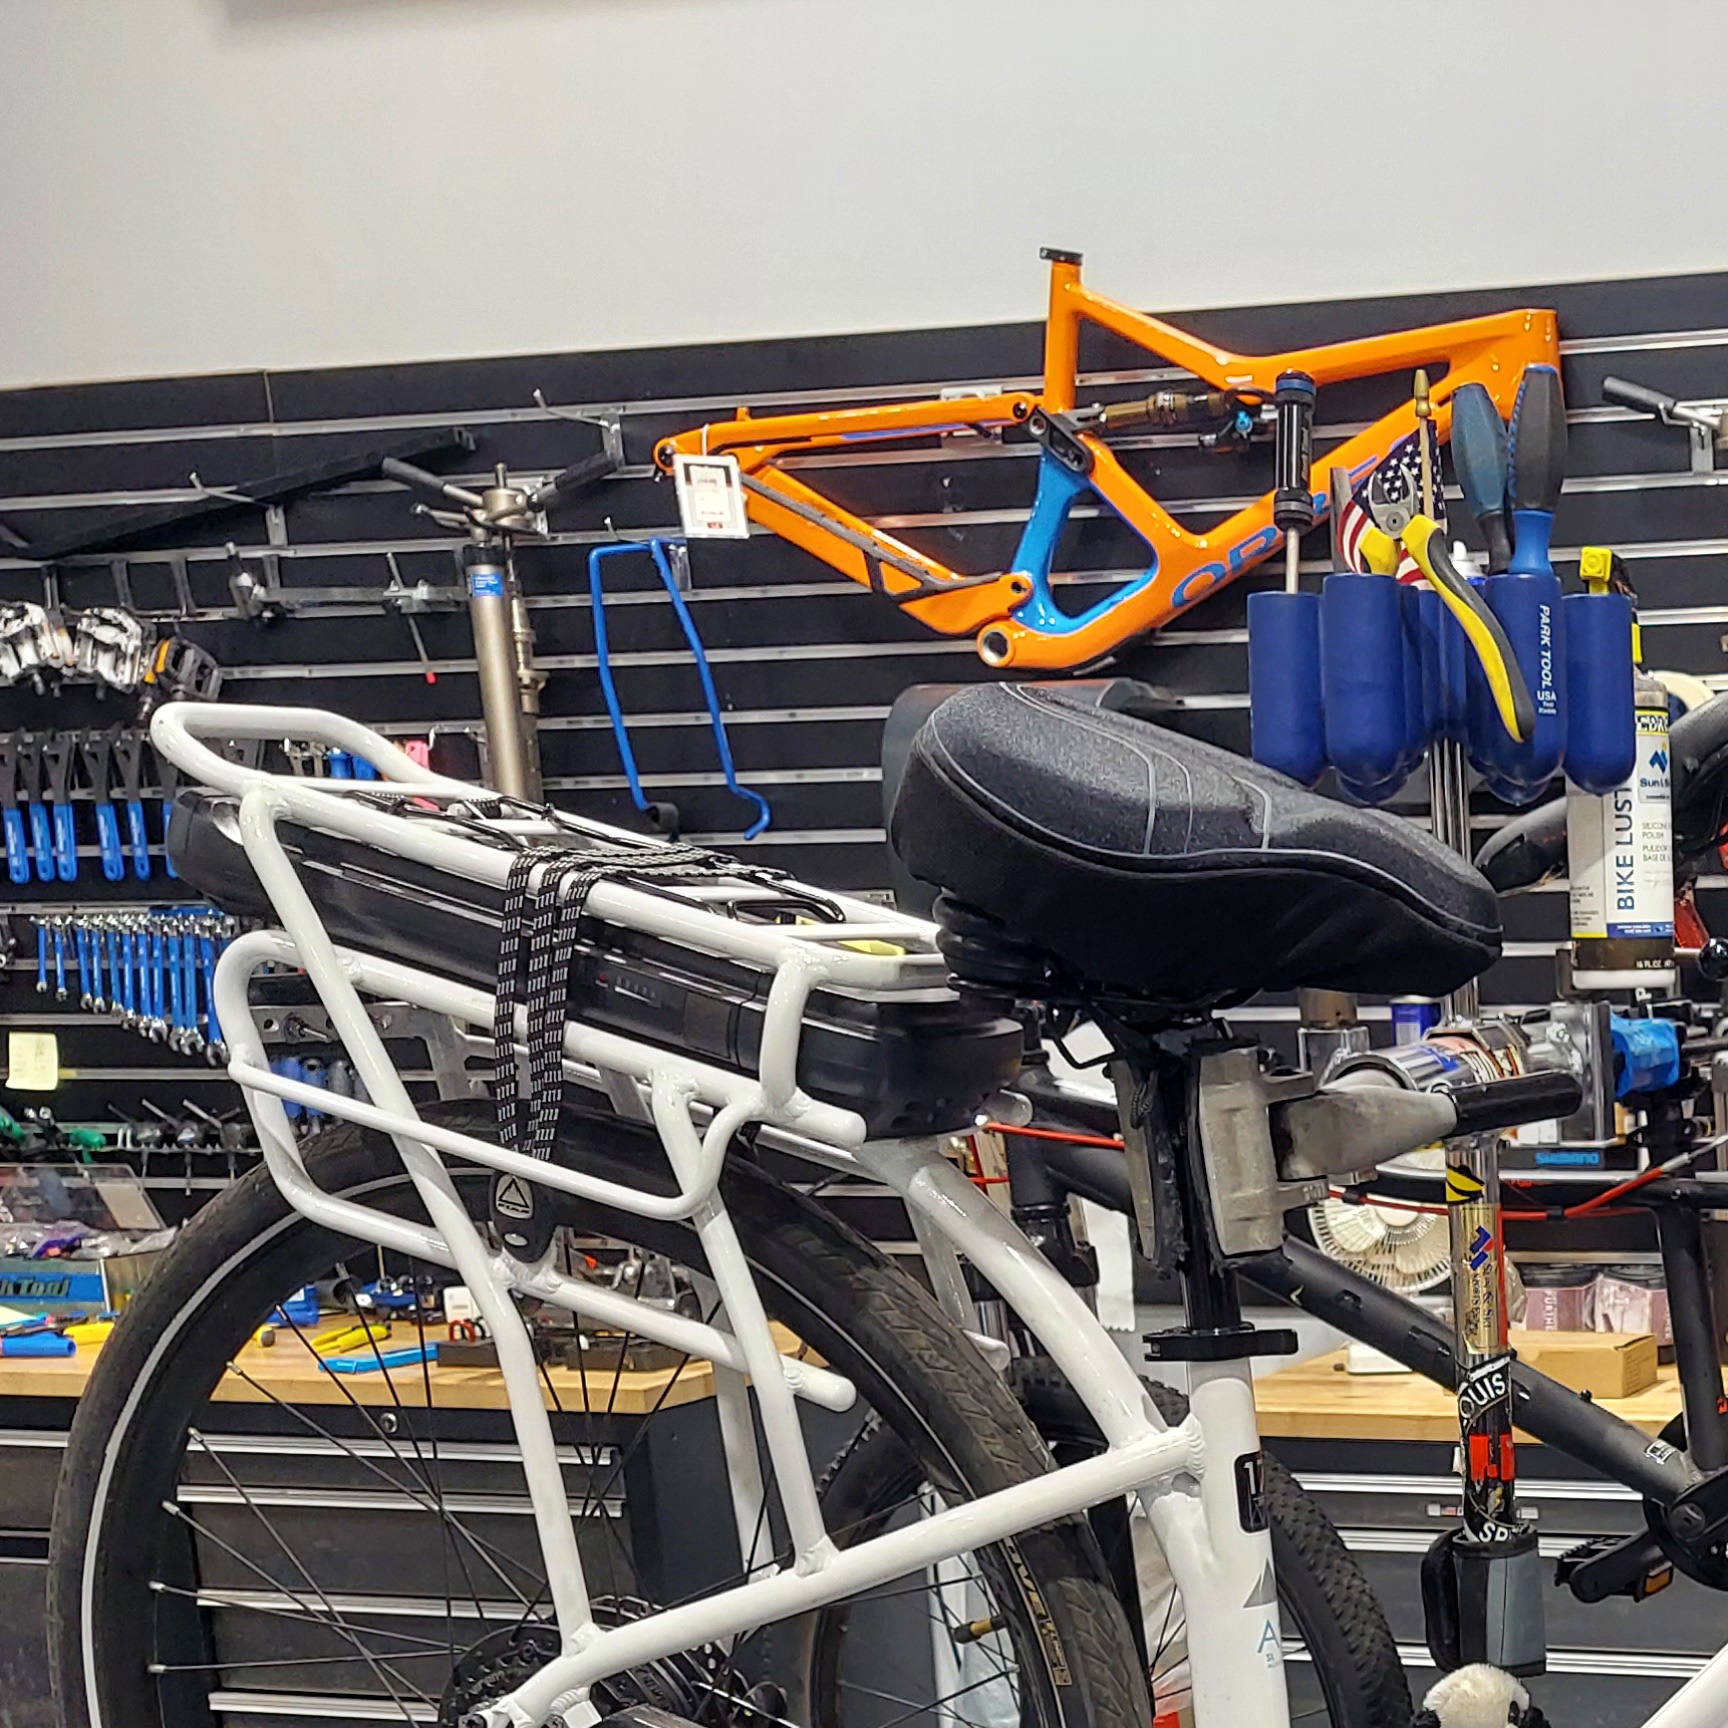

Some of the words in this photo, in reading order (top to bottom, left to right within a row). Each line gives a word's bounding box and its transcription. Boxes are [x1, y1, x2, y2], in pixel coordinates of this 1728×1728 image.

[1540, 604, 1552, 646] PARK
[1541, 650, 1552, 692] TOOL
[1537, 690, 1557, 700] USA
[1616, 855, 1635, 910] BIKE
